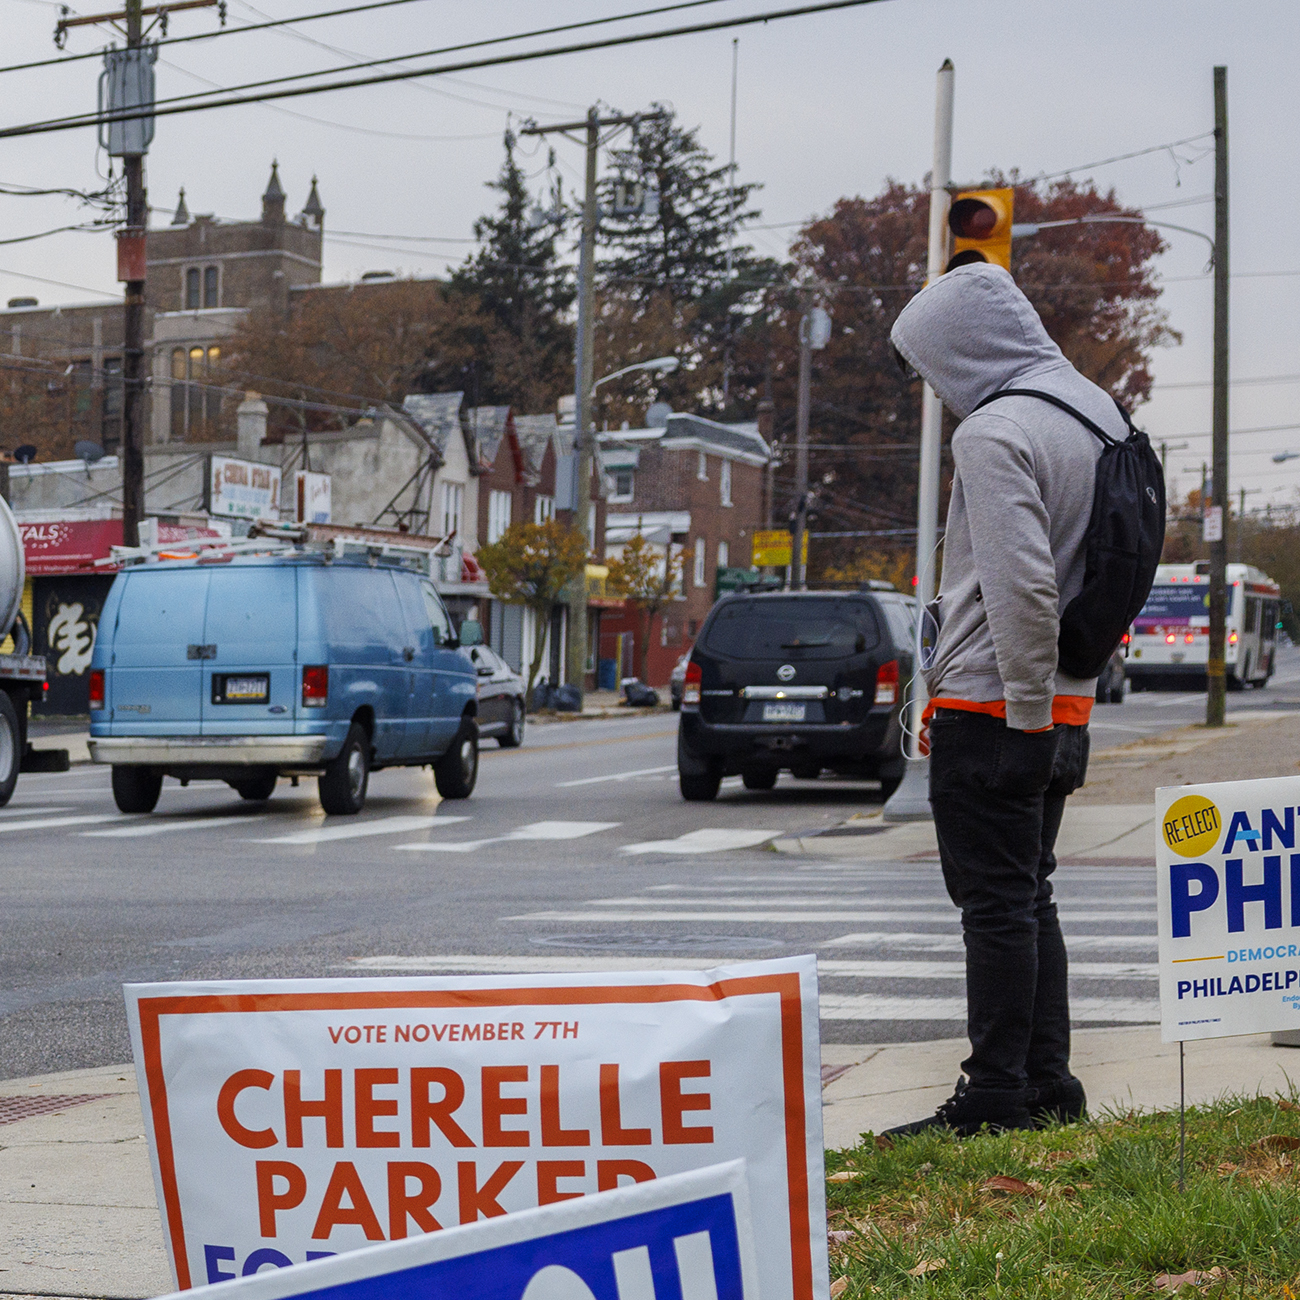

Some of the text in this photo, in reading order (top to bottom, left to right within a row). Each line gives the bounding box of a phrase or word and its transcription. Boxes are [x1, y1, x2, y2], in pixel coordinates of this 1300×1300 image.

[19, 525, 59, 541] TALS
[1164, 805, 1219, 846] RE-ELECT
[1221, 806, 1300, 855] AN
[1177, 970, 1300, 1000] PHILADELP
[328, 1020, 580, 1045] VOTE NOVEMBER 7TH
[216, 1059, 715, 1150] CHERELLE
